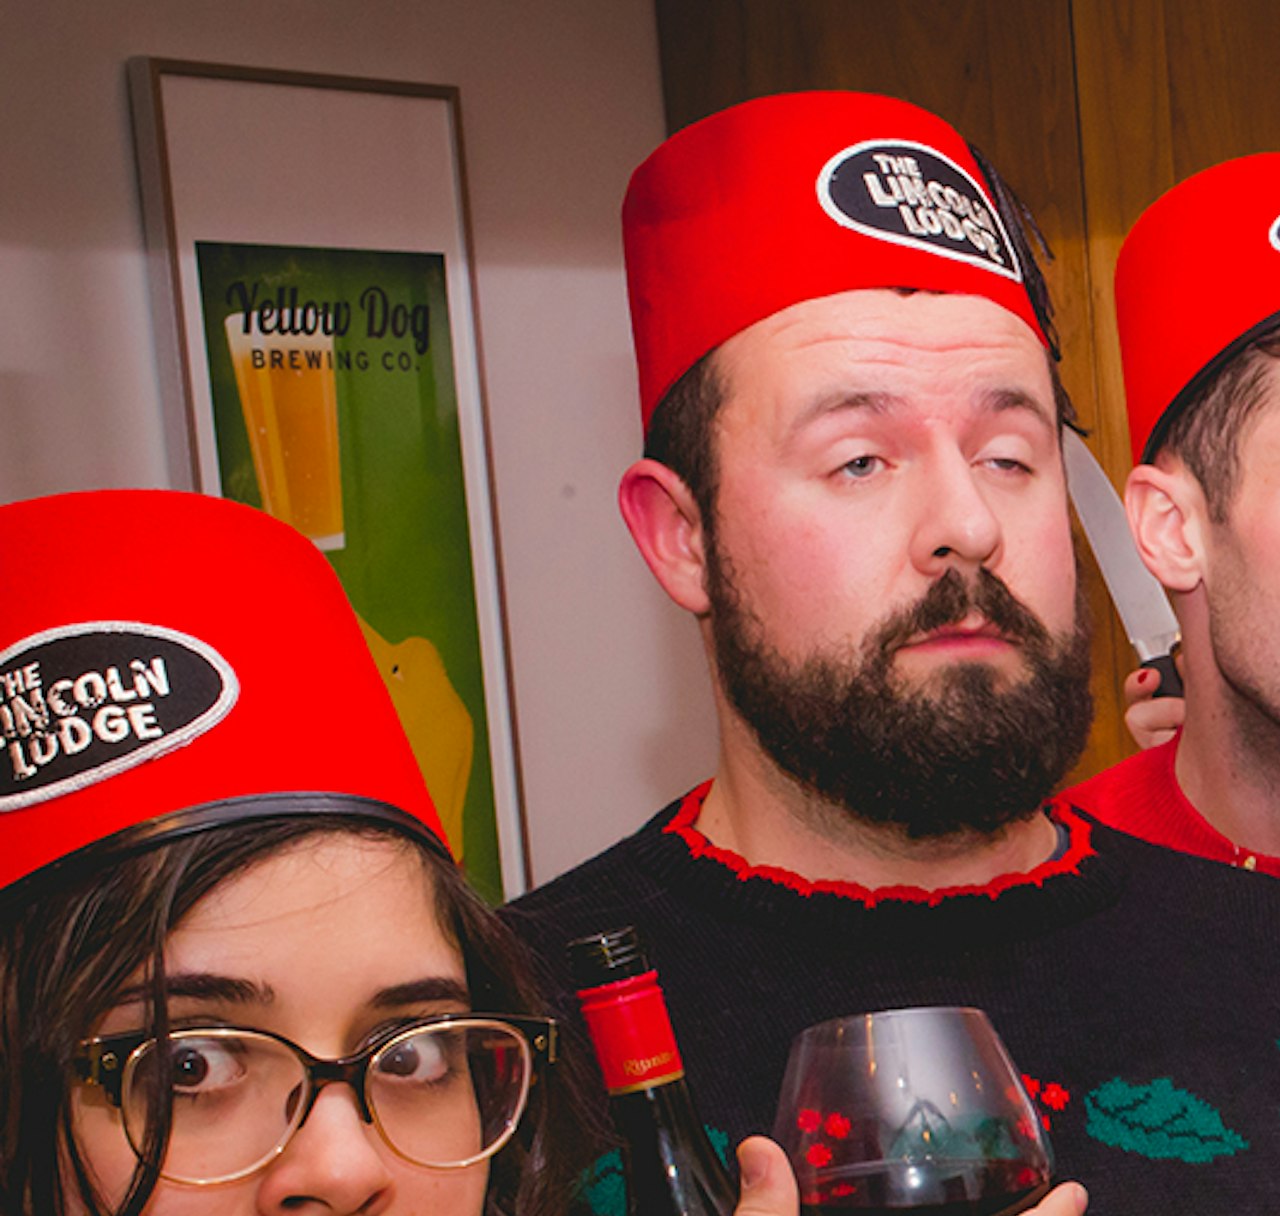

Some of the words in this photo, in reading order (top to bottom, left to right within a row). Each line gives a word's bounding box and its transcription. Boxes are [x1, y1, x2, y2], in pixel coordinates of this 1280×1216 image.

[873, 153, 922, 177] THE
[863, 172, 999, 238] LINCOLN
[900, 204, 1004, 264] LODGE
[226, 281, 351, 336] Yellow
[360, 286, 430, 355] Dog
[252, 350, 369, 371] BREWING
[381, 351, 421, 372] CO.
[9, 703, 164, 781] LODGE
